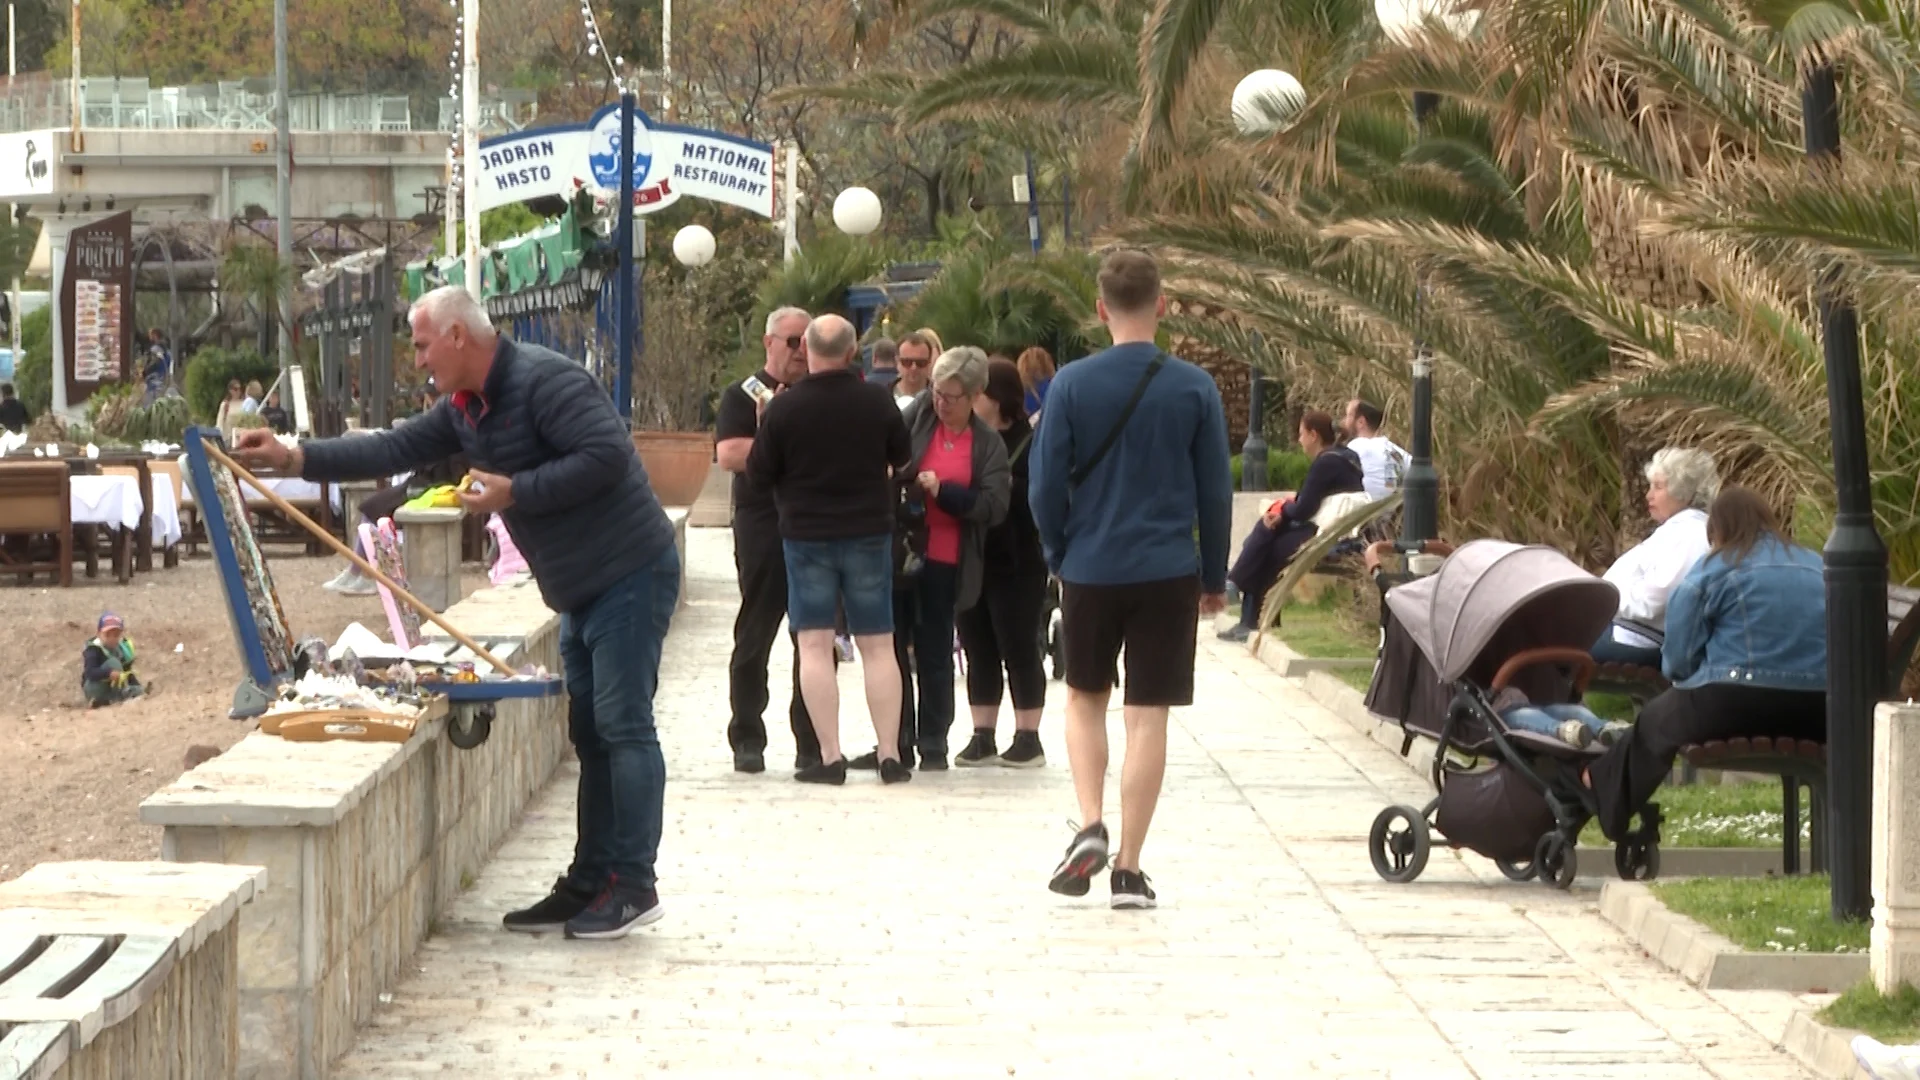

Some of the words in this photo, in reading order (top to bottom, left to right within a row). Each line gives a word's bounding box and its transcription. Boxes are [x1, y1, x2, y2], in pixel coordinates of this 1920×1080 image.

[480, 141, 554, 170] JADRAN
[682, 141, 767, 176] NATIONAL
[674, 163, 767, 197] RESTAURANT
